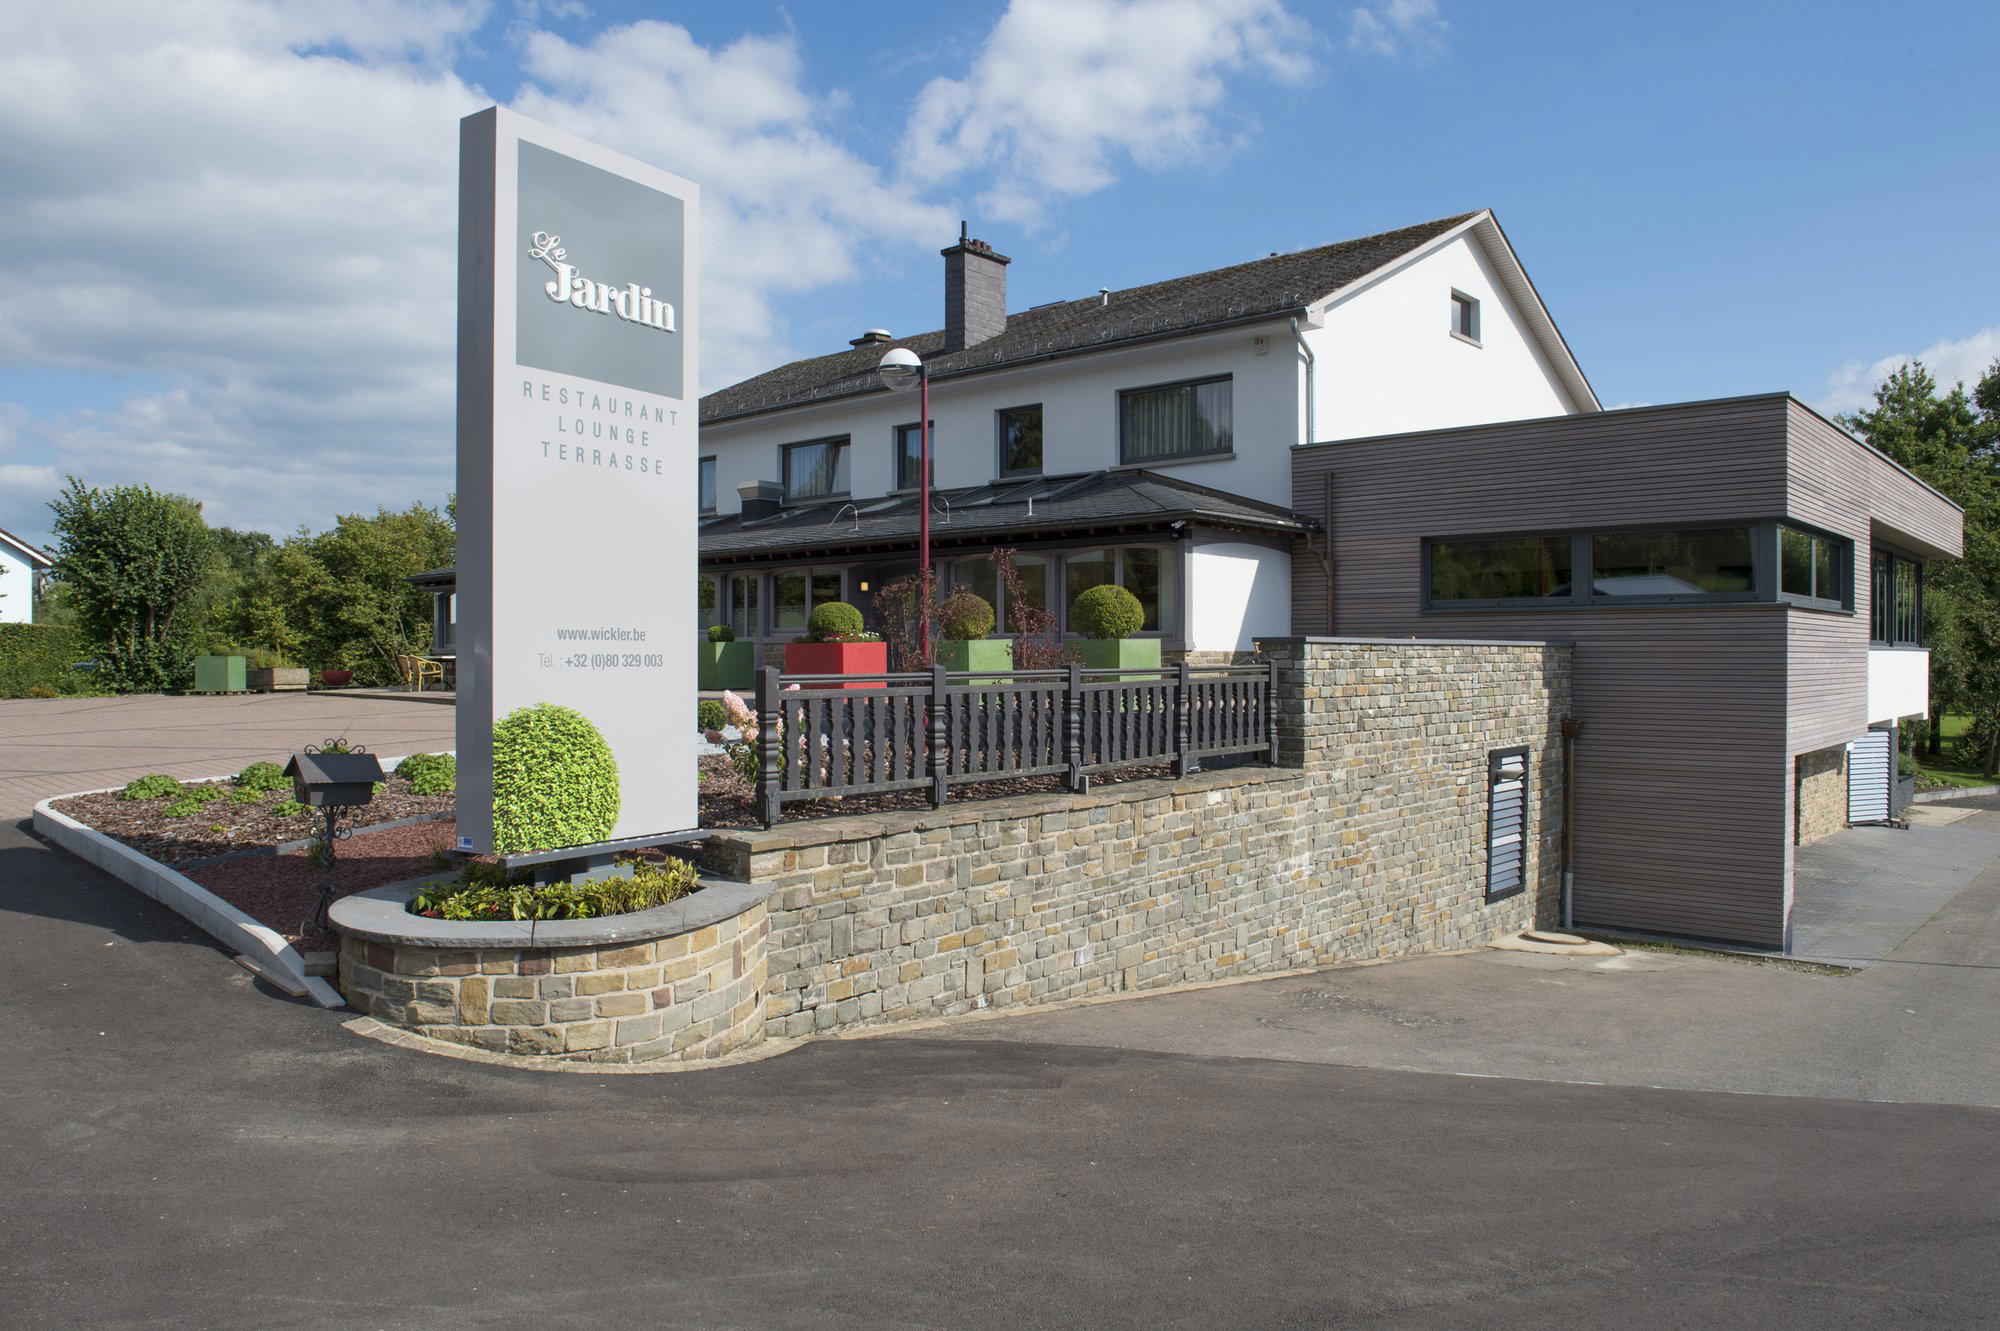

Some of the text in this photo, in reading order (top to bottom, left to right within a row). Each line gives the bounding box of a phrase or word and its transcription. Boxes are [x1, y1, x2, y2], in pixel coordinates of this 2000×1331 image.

[545, 262, 676, 333] Jardin
[523, 381, 678, 426] RESTAURANT
[558, 415, 649, 447] LOUNGE
[541, 441, 662, 475] TERRASSE
[557, 627, 646, 642] www.wickler.be
[565, 654, 587, 668] +32
[591, 653, 619, 670] (0)80
[622, 654, 641, 668] 329
[644, 654, 663, 668] 003
